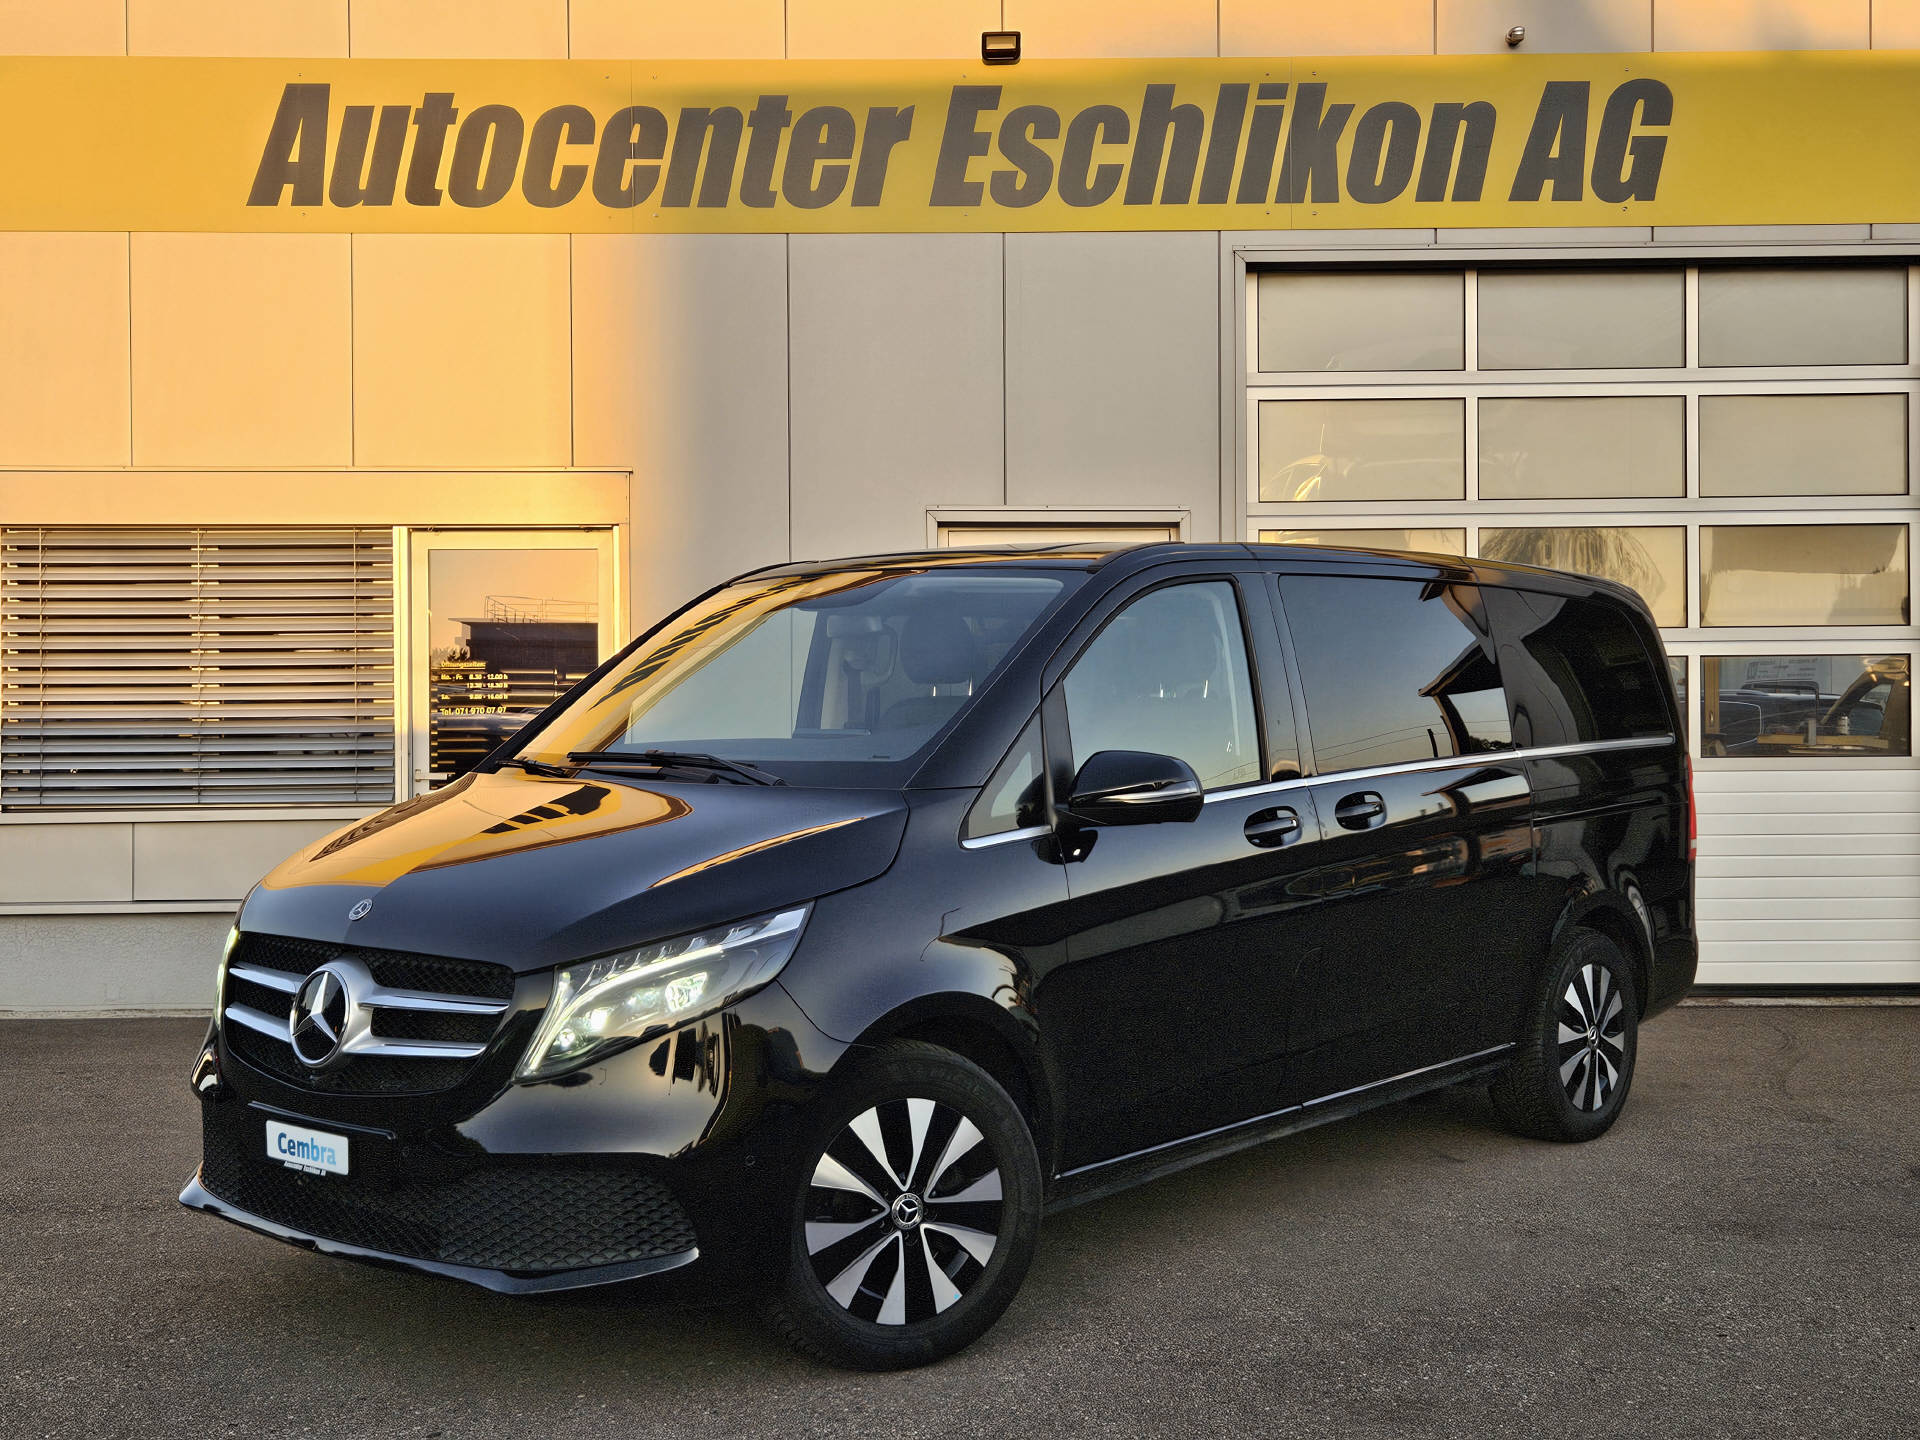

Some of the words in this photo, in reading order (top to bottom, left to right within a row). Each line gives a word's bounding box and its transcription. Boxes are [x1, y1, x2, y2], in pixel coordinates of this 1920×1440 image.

[245, 82, 916, 209] Autocenter
[928, 82, 1497, 208] Eschlikon
[1508, 78, 1674, 203] AG
[455, 707, 469, 715] 071
[470, 707, 485, 715] 970
[486, 706, 496, 714] 07
[497, 706, 507, 714] 07
[278, 1132, 337, 1166] Cembra
